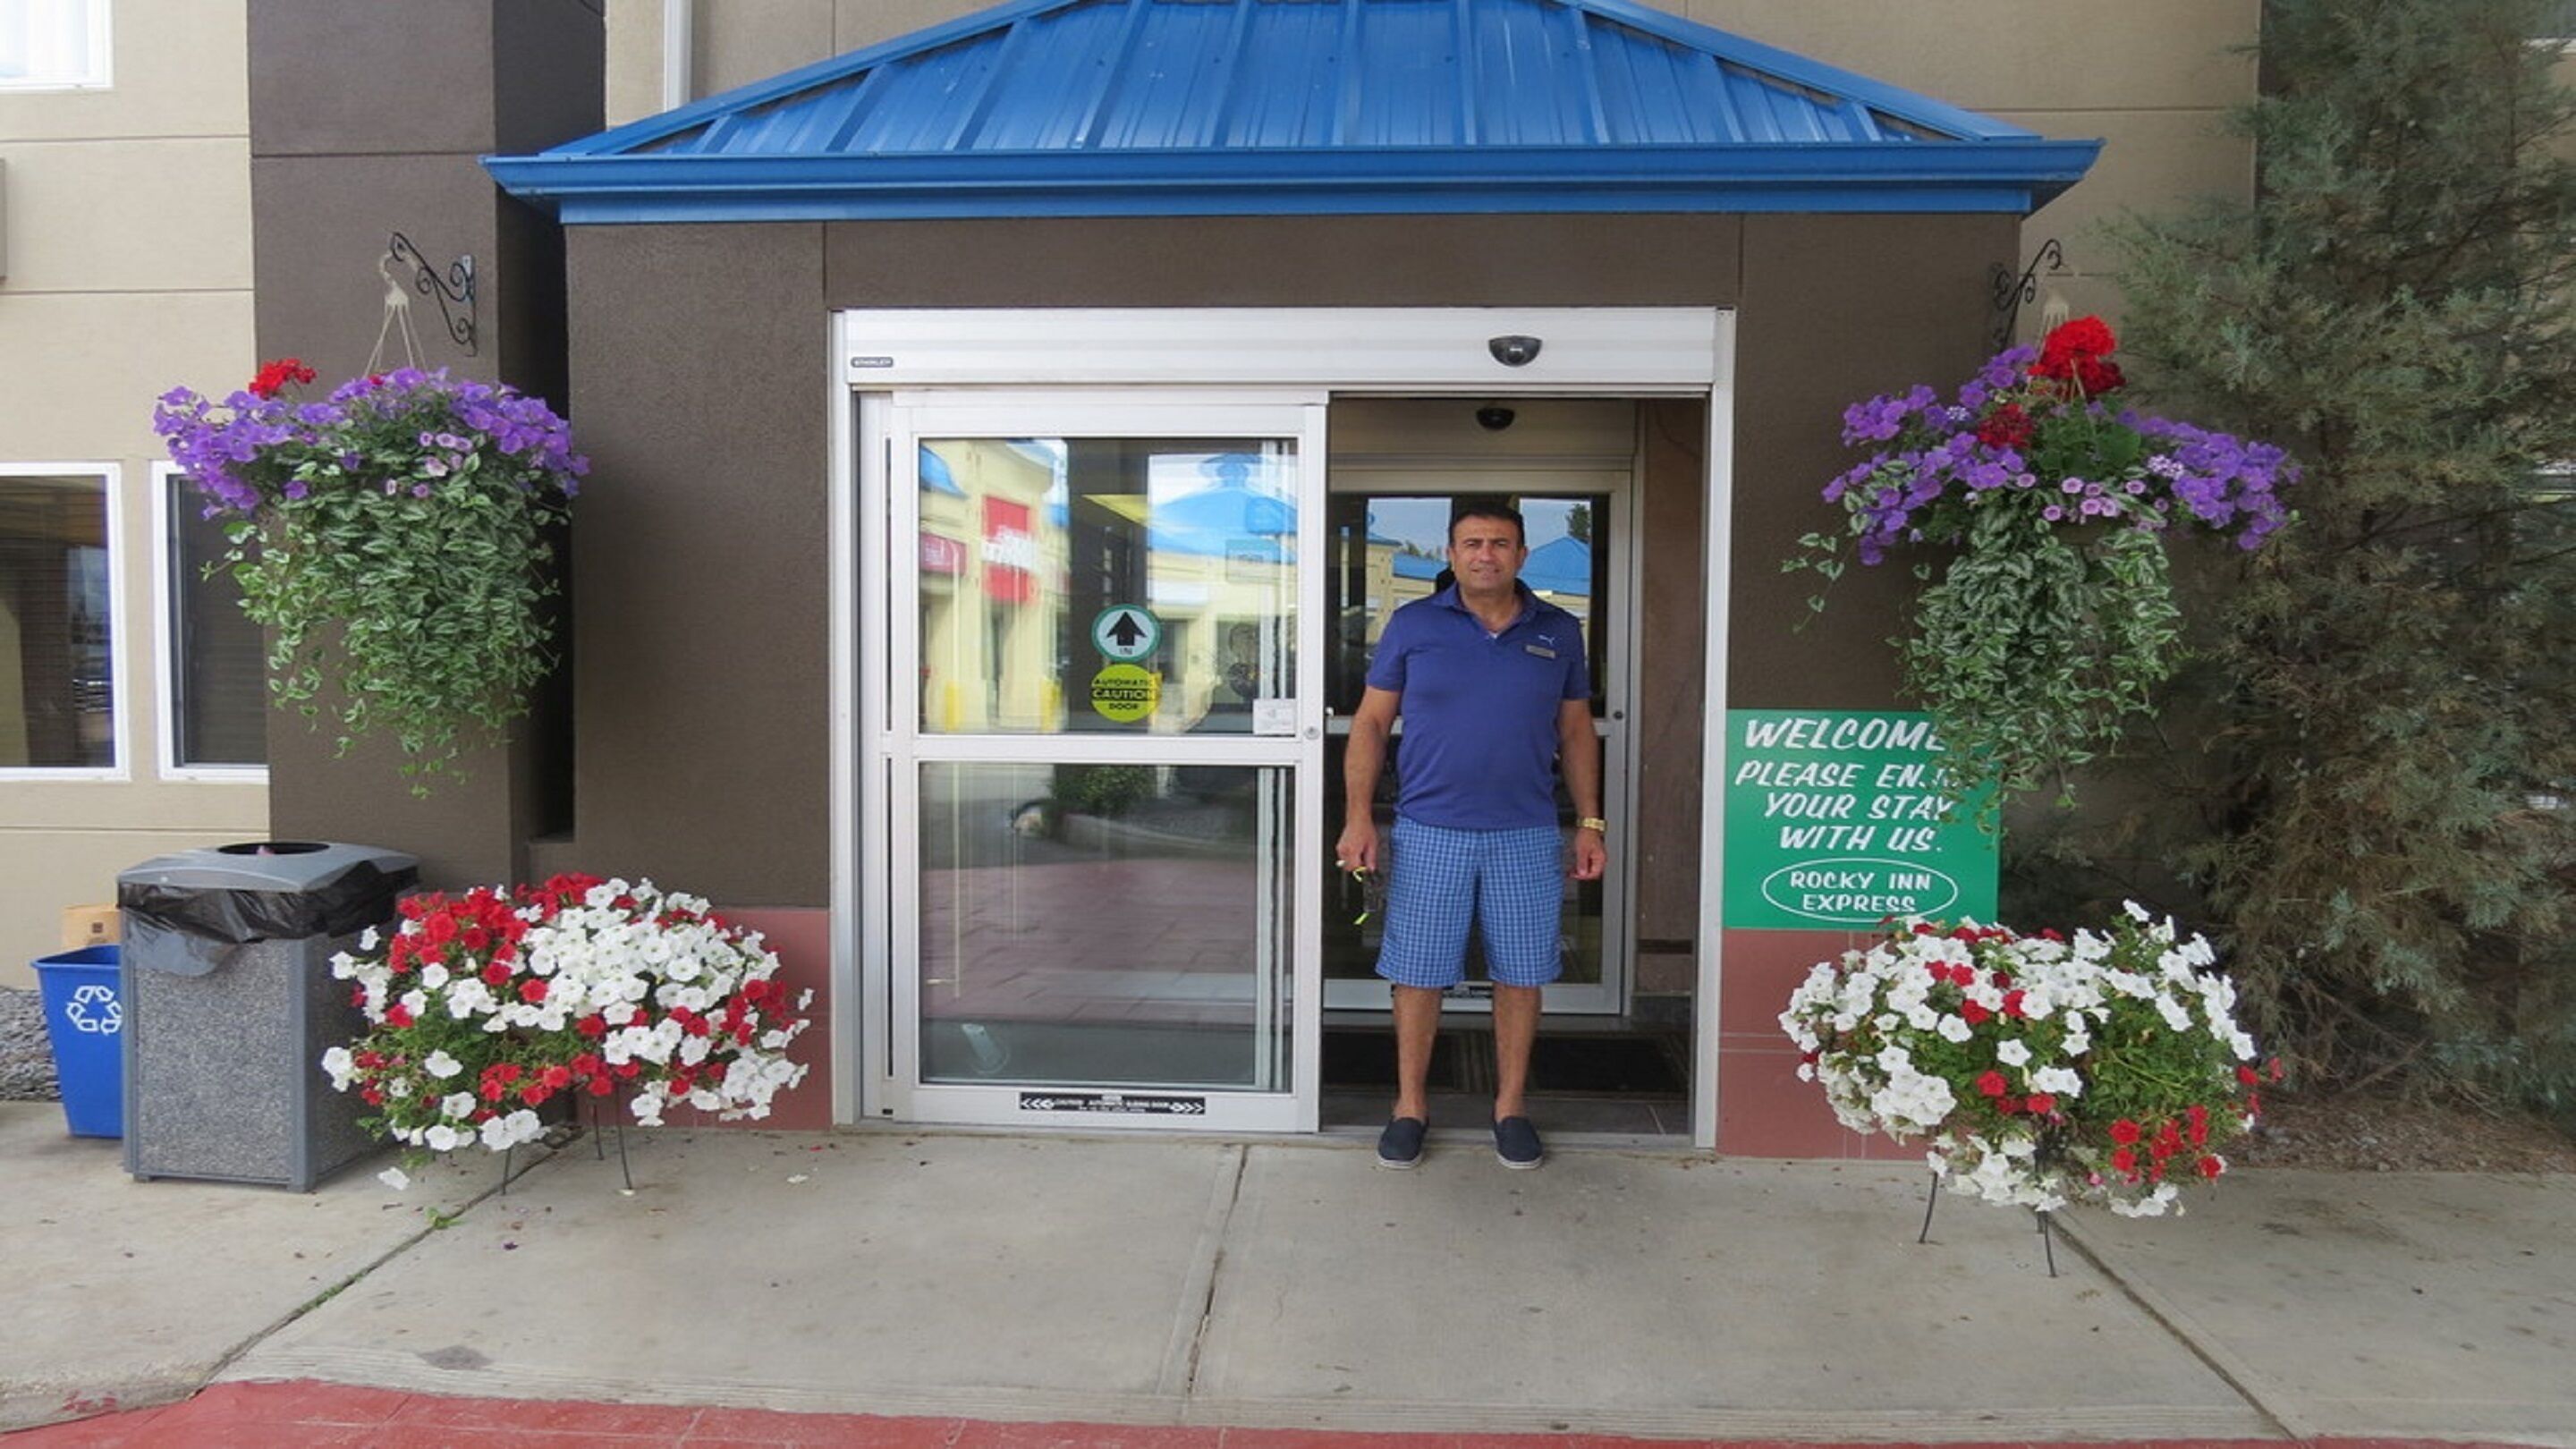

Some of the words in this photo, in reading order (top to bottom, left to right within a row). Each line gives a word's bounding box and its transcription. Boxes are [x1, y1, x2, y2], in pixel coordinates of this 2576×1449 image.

[1092, 690, 1156, 699] CAUTION
[1735, 760, 1865, 788] PLEASE
[1764, 792, 1857, 819] YOUR
[1867, 794, 1955, 820] STAY
[1780, 826, 1877, 851] WITH
[1887, 827, 1943, 852] US.
[1790, 870, 1876, 890] ROCKY
[1888, 873, 1931, 891] INN
[1802, 894, 1917, 912] EXPRESS
